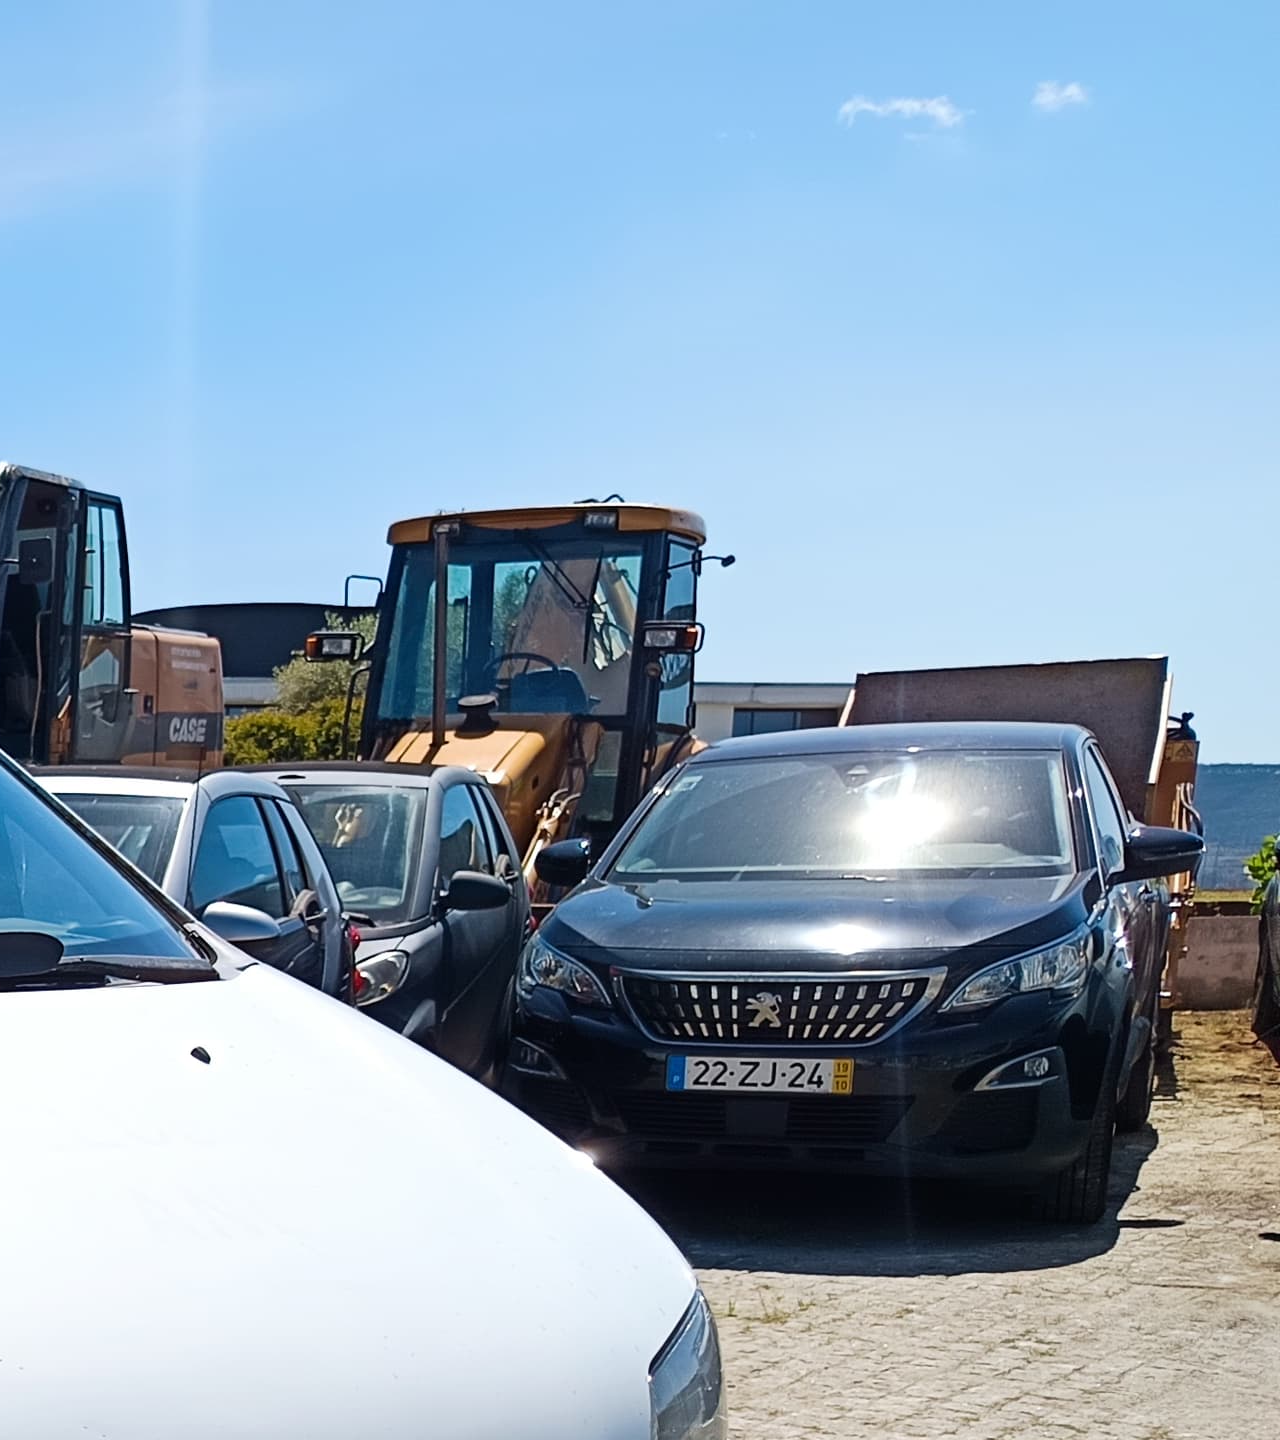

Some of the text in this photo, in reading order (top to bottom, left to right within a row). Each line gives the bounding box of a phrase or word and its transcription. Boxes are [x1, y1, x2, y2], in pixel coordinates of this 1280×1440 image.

[169, 717, 207, 743] CASE
[836, 1063, 849, 1074] 19
[835, 1080, 848, 1091] 10
